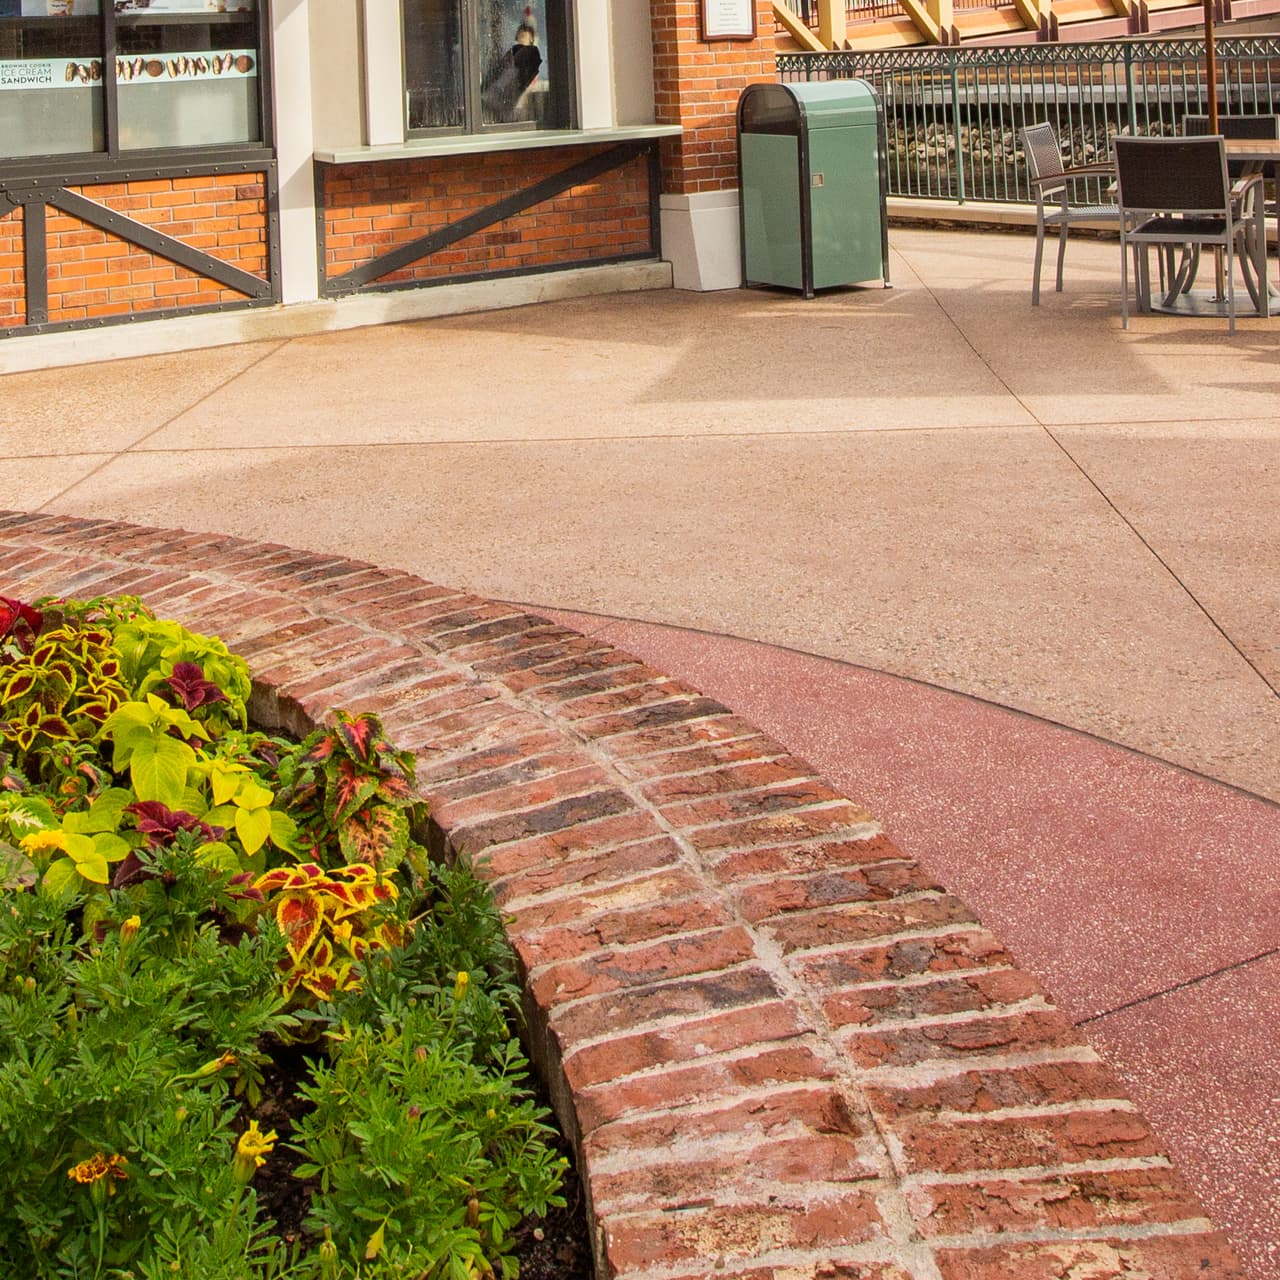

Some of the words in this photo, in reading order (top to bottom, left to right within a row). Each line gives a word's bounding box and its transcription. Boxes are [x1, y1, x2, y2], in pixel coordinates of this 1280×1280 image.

[0, 68, 16, 77] ICE
[18, 67, 52, 76] CREAM
[0, 75, 52, 85] SANDWICH
